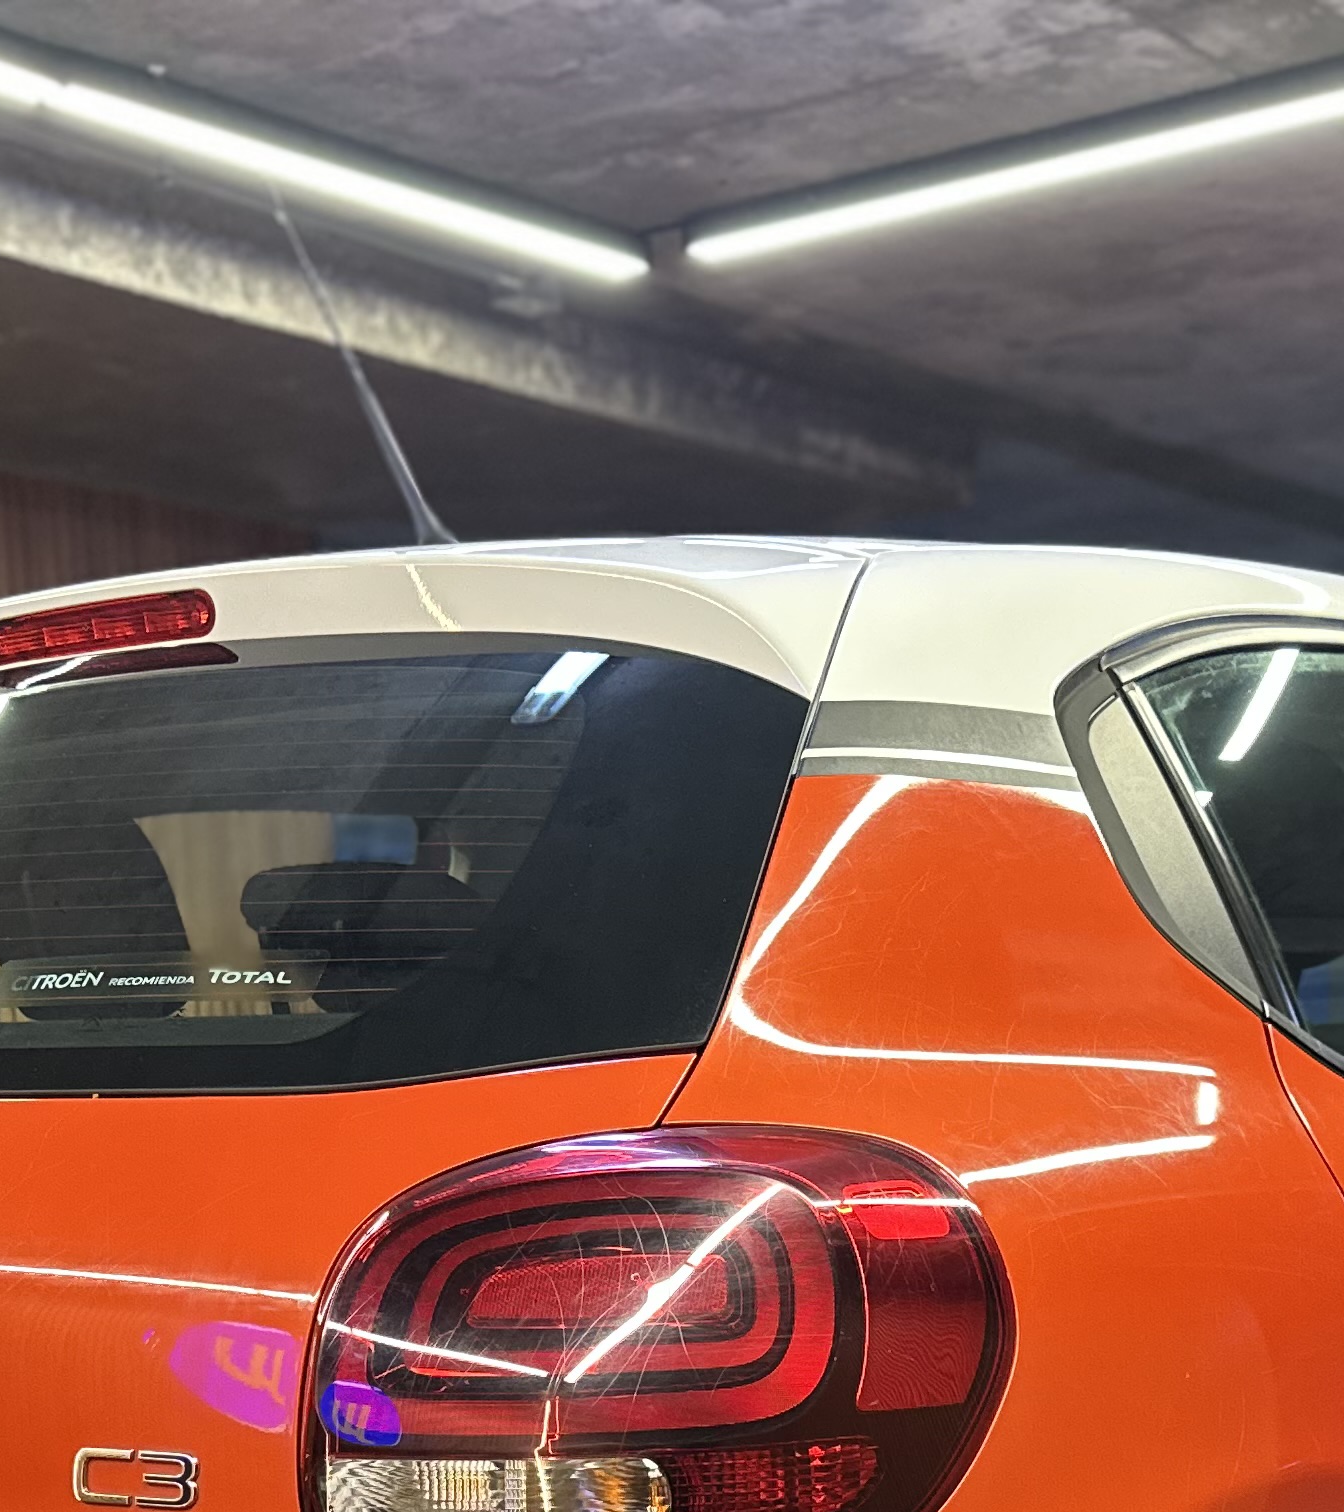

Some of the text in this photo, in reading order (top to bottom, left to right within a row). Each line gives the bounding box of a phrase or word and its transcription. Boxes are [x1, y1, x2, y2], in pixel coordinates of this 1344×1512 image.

[11, 969, 292, 991] CITROËN RECOMIENDA TOTAL
[72, 1447, 200, 1509] C3
